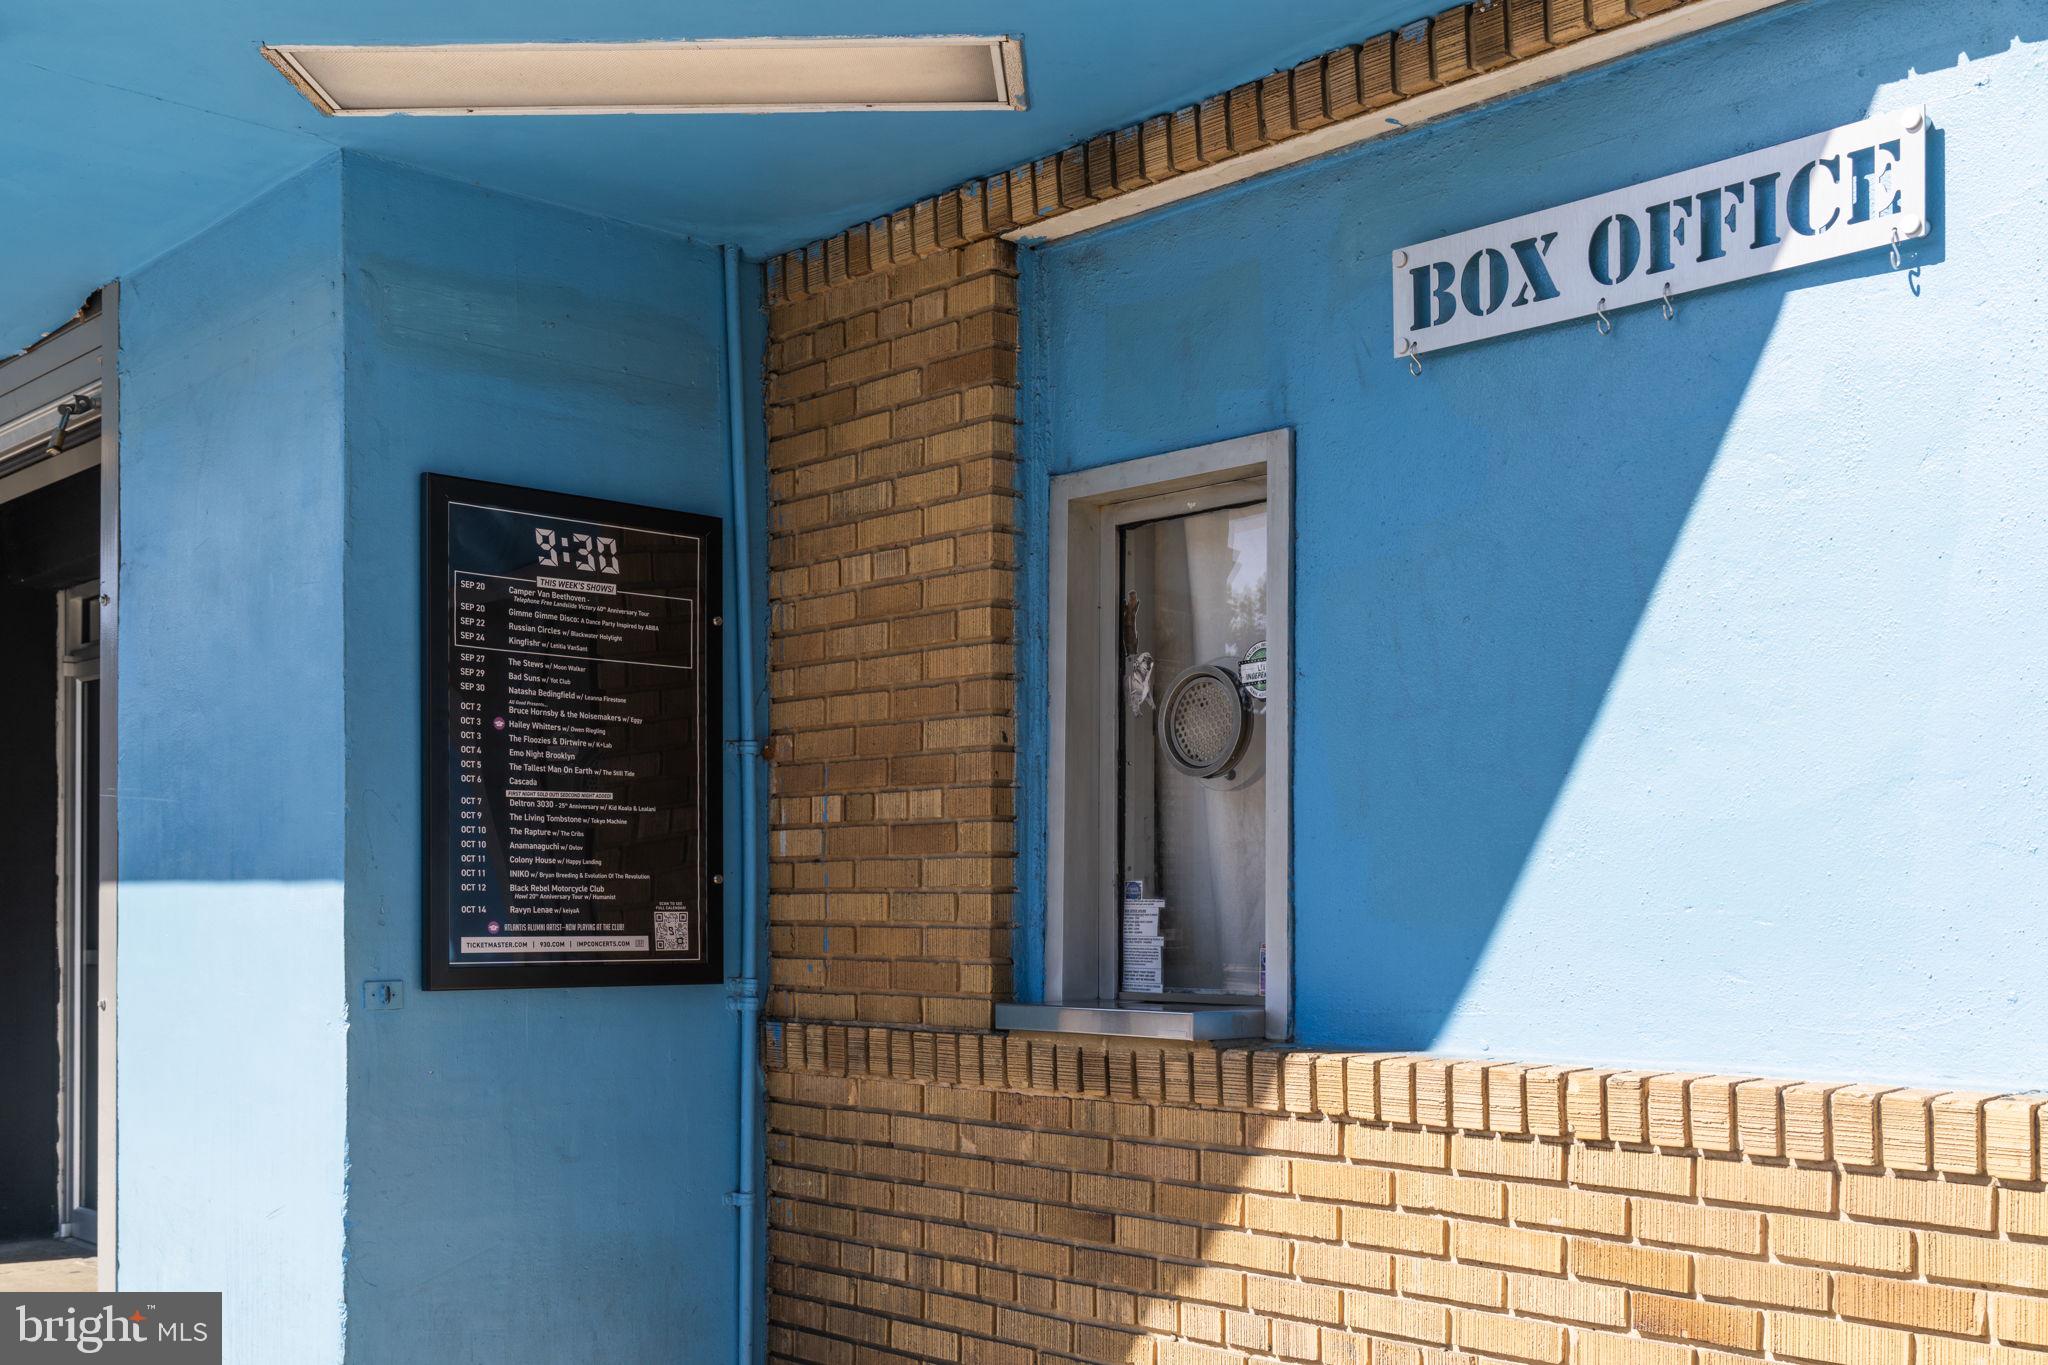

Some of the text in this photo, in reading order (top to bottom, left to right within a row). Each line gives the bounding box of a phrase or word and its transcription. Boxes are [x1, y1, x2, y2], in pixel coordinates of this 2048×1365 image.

[1409, 138, 1902, 331] BOX OFFICE
[535, 527, 620, 575] 9:30
[460, 579, 485, 590] SEP 20
[540, 578, 615, 595] THIS WEEK'S SHOWS!
[508, 585, 586, 602] Camper Van Beethoven
[460, 601, 485, 612] SEP 20
[513, 595, 540, 606] Telephone
[578, 603, 596, 612] Victory
[606, 606, 637, 616] Anniversary
[460, 616, 485, 627] SEP 22
[508, 607, 532, 618] Gimme
[534, 610, 558, 620] Gimme
[559, 613, 579, 623] Disco:
[601, 619, 615, 628] Party
[616, 621, 637, 630] Inspired
[508, 622, 535, 632] Russian
[537, 625, 560, 635] Circles
[460, 631, 484, 641] SEP 24
[508, 636, 540, 648] Kingfishr
[460, 652, 484, 662] SEP 27
[507, 657, 521, 666] The
[522, 658, 543, 668] Stews
[567, 664, 586, 672] Walker
[460, 667, 485, 677] SEP 29
[508, 671, 522, 680] Bad
[523, 673, 540, 682] Suns
[460, 681, 485, 691] SEP 30
[508, 686, 536, 696] Natasha
[537, 688, 575, 701] Bedingfield
[460, 701, 481, 711] OCT 2
[508, 705, 642, 724] Bruce Hornsby the Noisemakers Eggy
[460, 716, 481, 725] OCT 3
[508, 719, 561, 731] Hailey Whitters
[460, 730, 481, 739] OCT 3
[508, 734, 521, 742] The
[559, 737, 586, 747] Dirtwire
[460, 745, 475, 753] OCT
[509, 748, 575, 761] Emo Night Brooklyn
[460, 759, 481, 768] OCT 5
[508, 762, 522, 771] The
[523, 763, 546, 772] Tallest
[547, 764, 562, 773] Man
[563, 765, 573, 774] On
[574, 766, 592, 774] Earth
[460, 774, 481, 783] OCT 6
[508, 776, 537, 786] Cascada
[460, 796, 475, 805] OCT
[509, 798, 535, 807] Deltron
[536, 799, 554, 808] 3030
[568, 802, 599, 811] Anniversary
[460, 810, 481, 819] OCT 9
[509, 812, 522, 821] The
[524, 813, 544, 823] Living
[546, 814, 581, 823] Tombstone
[460, 825, 475, 833] OCT
[509, 826, 522, 835] The
[524, 827, 551, 837] Rapture
[460, 839, 486, 848] OCT 10
[509, 841, 559, 851] Anamanaguchi
[460, 854, 485, 862] OCT 11
[509, 855, 533, 865] Colony
[534, 856, 556, 864] House
[582, 858, 601, 866] Landing
[461, 868, 475, 876] OCT
[509, 869, 529, 877] INIKO
[461, 883, 486, 891] OCT 12
[509, 883, 604, 893] Black Rebel Motorcycle Club
[461, 905, 486, 913] OCT 14
[509, 905, 531, 914] Ravyn
[532, 905, 553, 913] Lenae
[577, 923, 595, 931] PLAYING
